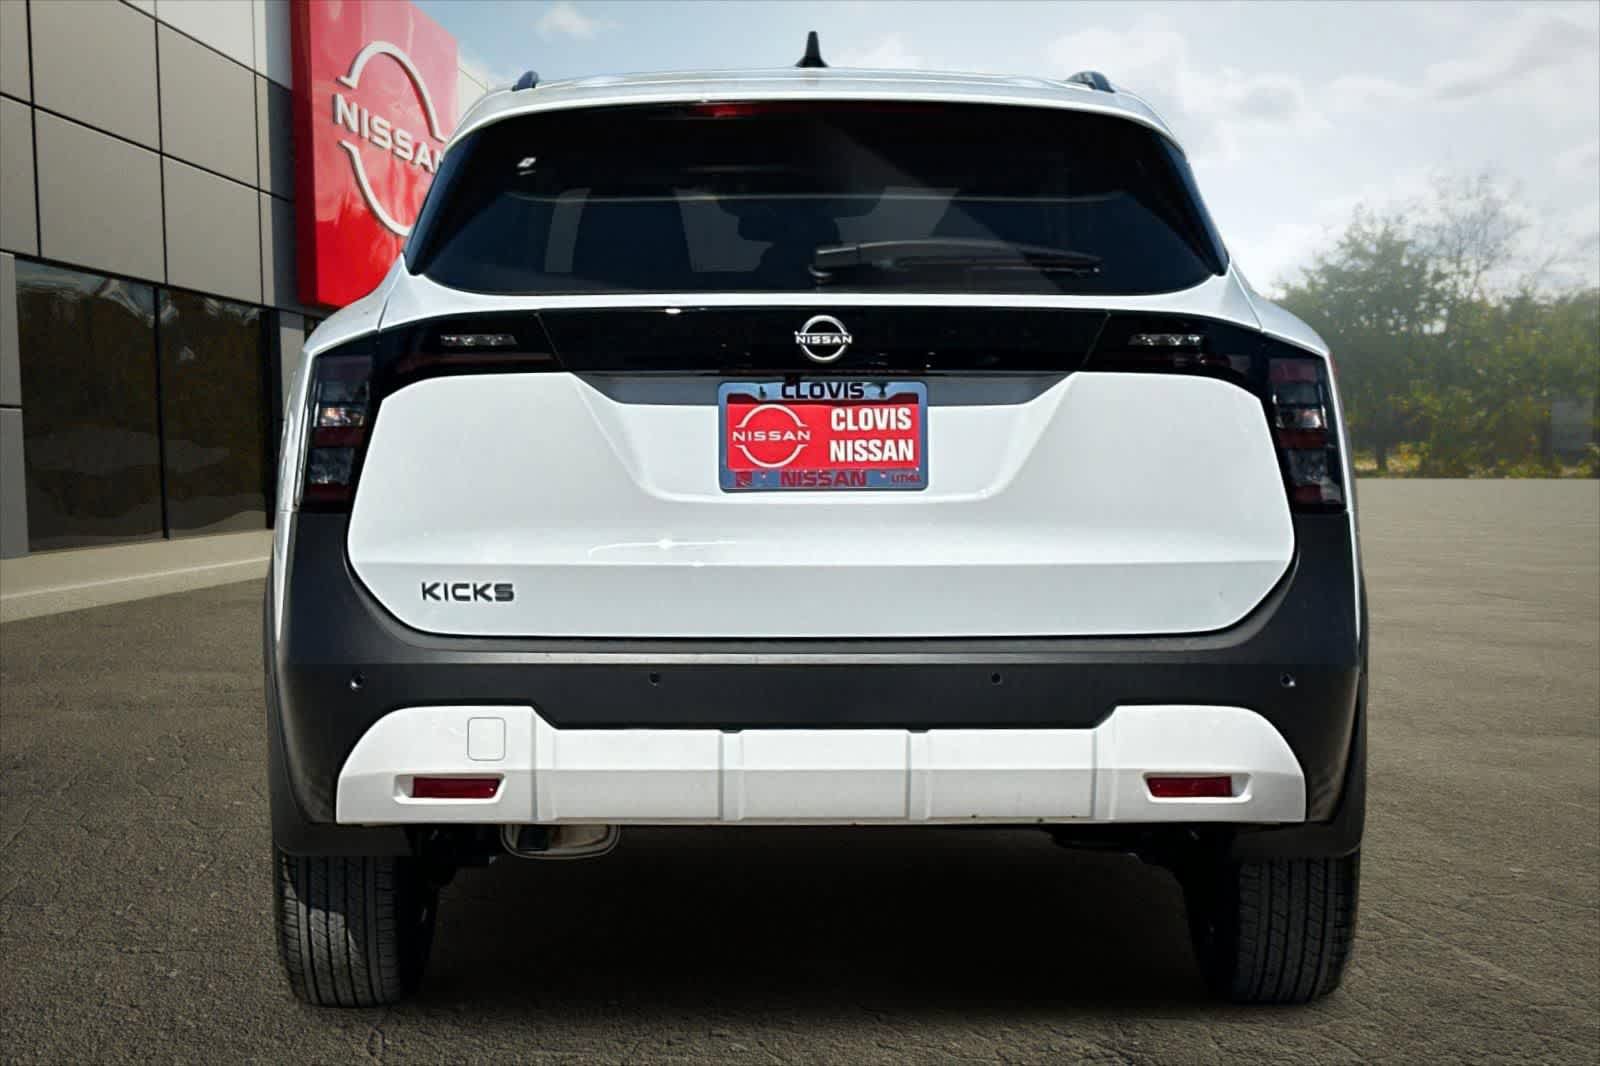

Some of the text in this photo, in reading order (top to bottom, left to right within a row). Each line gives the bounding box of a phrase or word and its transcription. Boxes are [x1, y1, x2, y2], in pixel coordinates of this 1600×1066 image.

[795, 335, 852, 345] NISSAN
[781, 382, 865, 400] CLOVIS
[830, 408, 912, 431] CLOVIS
[732, 431, 811, 442] NISSAN
[829, 439, 914, 462] NISSAN
[780, 470, 867, 487] NISSAN
[421, 582, 515, 602] KICKS
